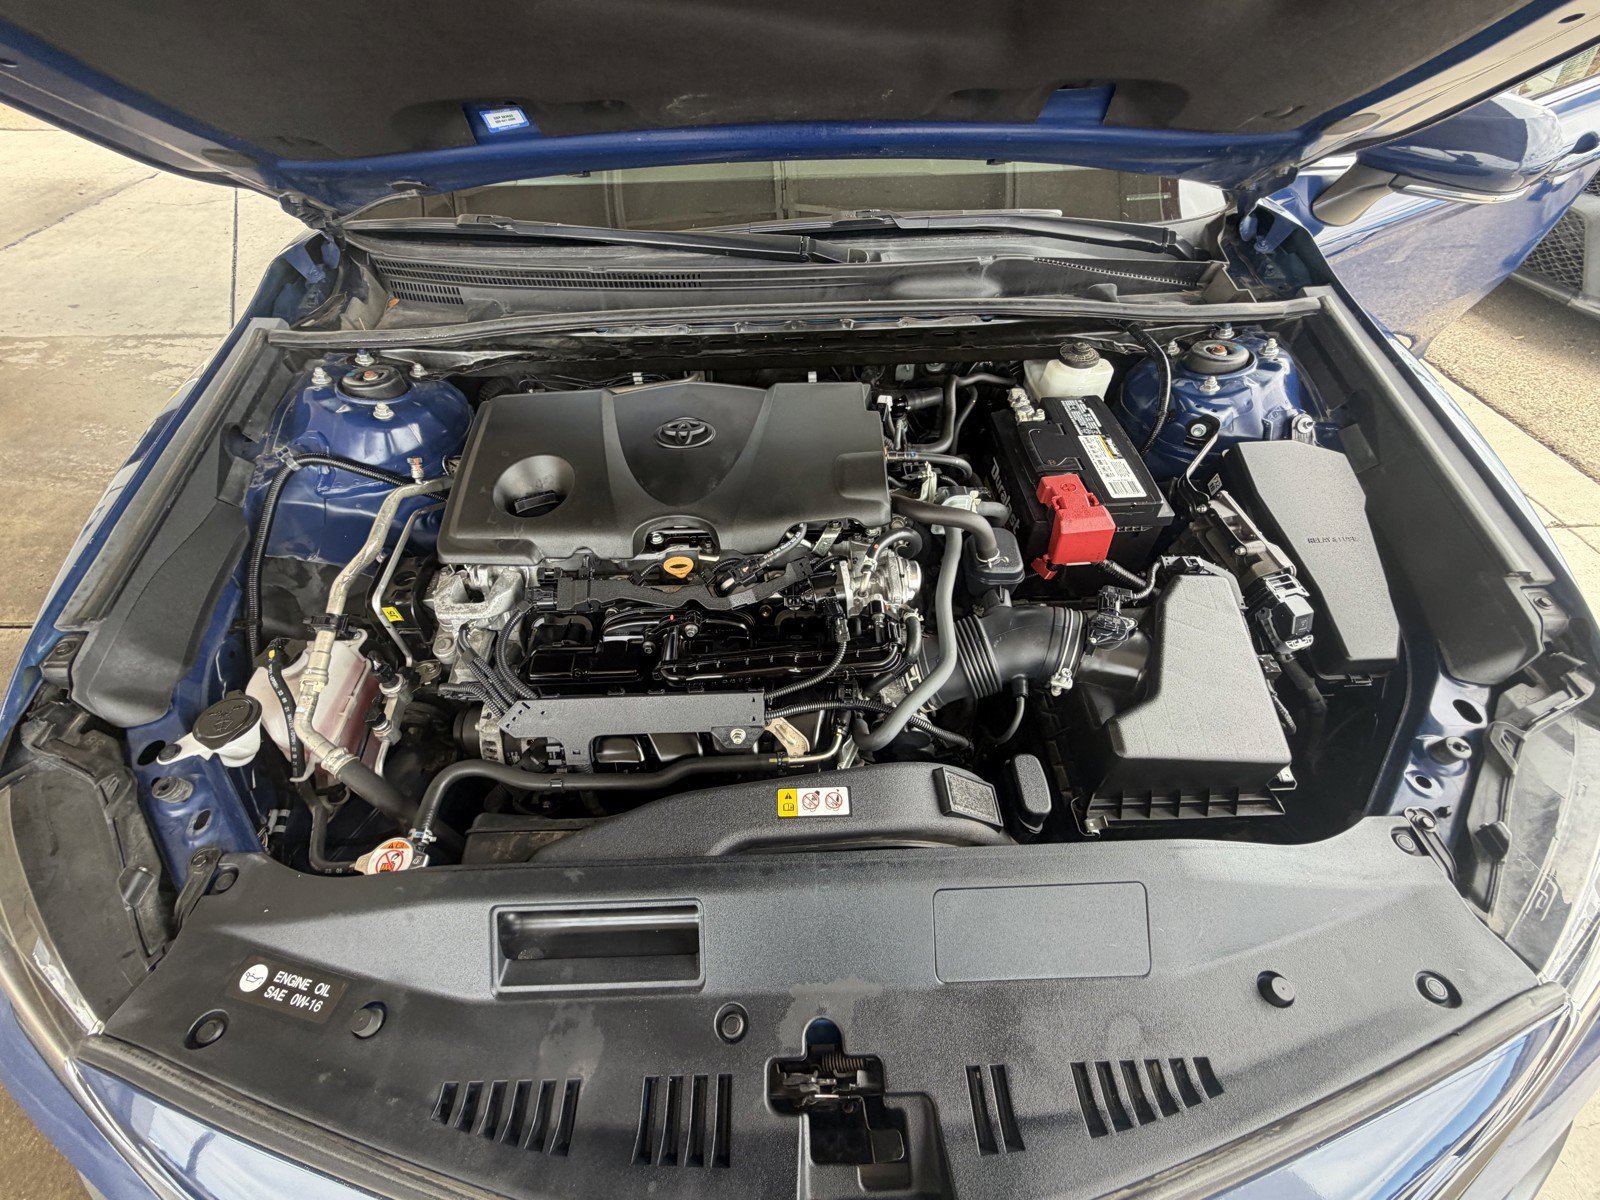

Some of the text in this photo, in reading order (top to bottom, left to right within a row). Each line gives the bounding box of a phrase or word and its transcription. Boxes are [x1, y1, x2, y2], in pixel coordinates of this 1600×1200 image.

[273, 970, 331, 998] ENGINE OIL
[263, 985, 324, 1013] SAE 0W-16
